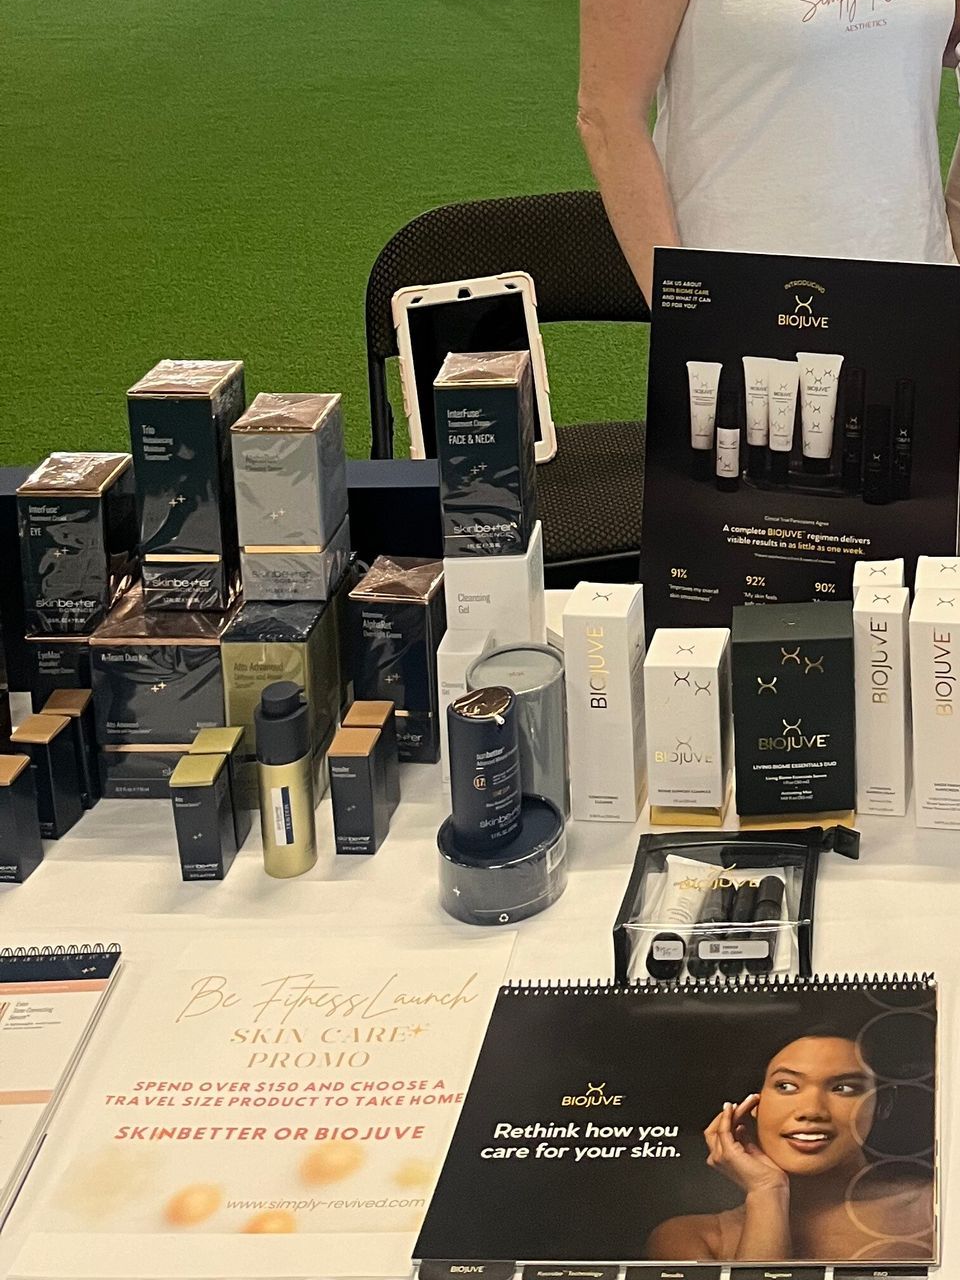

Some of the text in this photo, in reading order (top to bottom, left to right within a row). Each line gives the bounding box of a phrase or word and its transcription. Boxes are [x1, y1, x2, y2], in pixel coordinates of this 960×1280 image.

[845, 19, 887, 32] AESTHETICS
[778, 314, 829, 329] BIOJUVE
[448, 433, 495, 445] FACE & NECK
[722, 524, 730, 532] A
[731, 525, 766, 536] complete
[807, 532, 839, 544] regimen
[840, 535, 871, 545] delivers
[727, 536, 751, 545] visible
[752, 538, 778, 548] results
[779, 540, 787, 548] in
[798, 541, 816, 551] little
[842, 546, 866, 555] week.
[670, 568, 687, 579] 91%
[745, 576, 766, 587] 92%
[815, 582, 836, 593] 90%
[458, 605, 470, 615] Gel
[587, 623, 609, 710] BIOJUVE
[870, 616, 893, 704] BIOJUVE
[933, 626, 957, 716] BIOJUVE
[654, 750, 713, 765] BIOJUVE
[175, 972, 479, 1025] Be Fitness Launch
[229, 1025, 409, 1044] SKIN CARE
[245, 1049, 372, 1069] PROMO
[133, 1078, 446, 1093] SPEND OVER $150 AND CHOOSE A
[105, 1092, 465, 1108] TRAVEL SIZE PRODUCT TO TAKE HOME
[561, 1095, 625, 1108] BIOJUVE
[114, 1125, 426, 1141] SKINBETTER OR BIOJUVE
[493, 1122, 679, 1141] Rethink how you
[480, 1141, 681, 1162] care for your skin.
[226, 1196, 427, 1212] www.simply-revived.com
